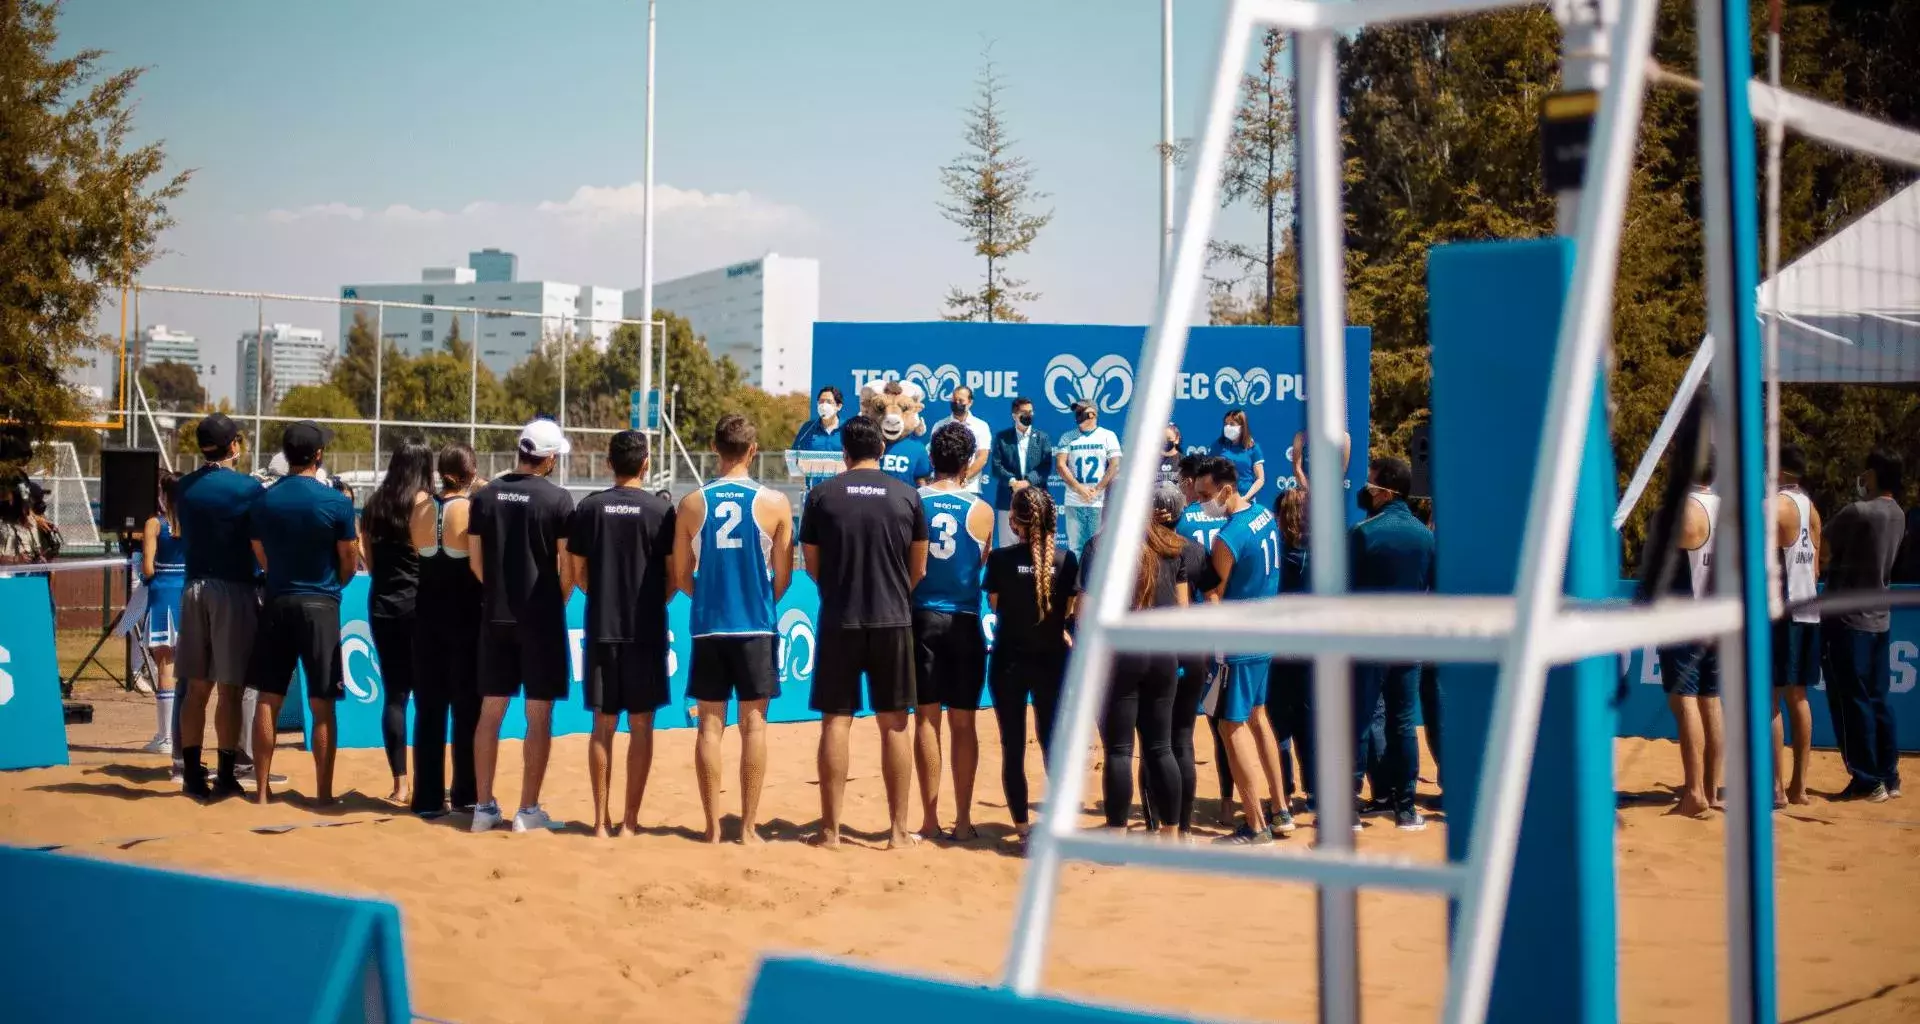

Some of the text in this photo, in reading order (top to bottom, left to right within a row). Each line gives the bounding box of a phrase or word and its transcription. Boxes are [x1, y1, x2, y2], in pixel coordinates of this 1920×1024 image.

[966, 371, 1019, 398] PUE
[1175, 373, 1309, 401] EC PU
[881, 455, 910, 473] EC
[1075, 456, 1099, 484] 12
[497, 493, 508, 501] TEC
[846, 486, 858, 494] TEC
[604, 505, 640, 514] TEC PUE
[714, 501, 743, 549] 2
[929, 512, 958, 560] 3
[1801, 528, 1809, 548] 2
[1261, 530, 1280, 576] 11
[1017, 565, 1030, 573] TEC
